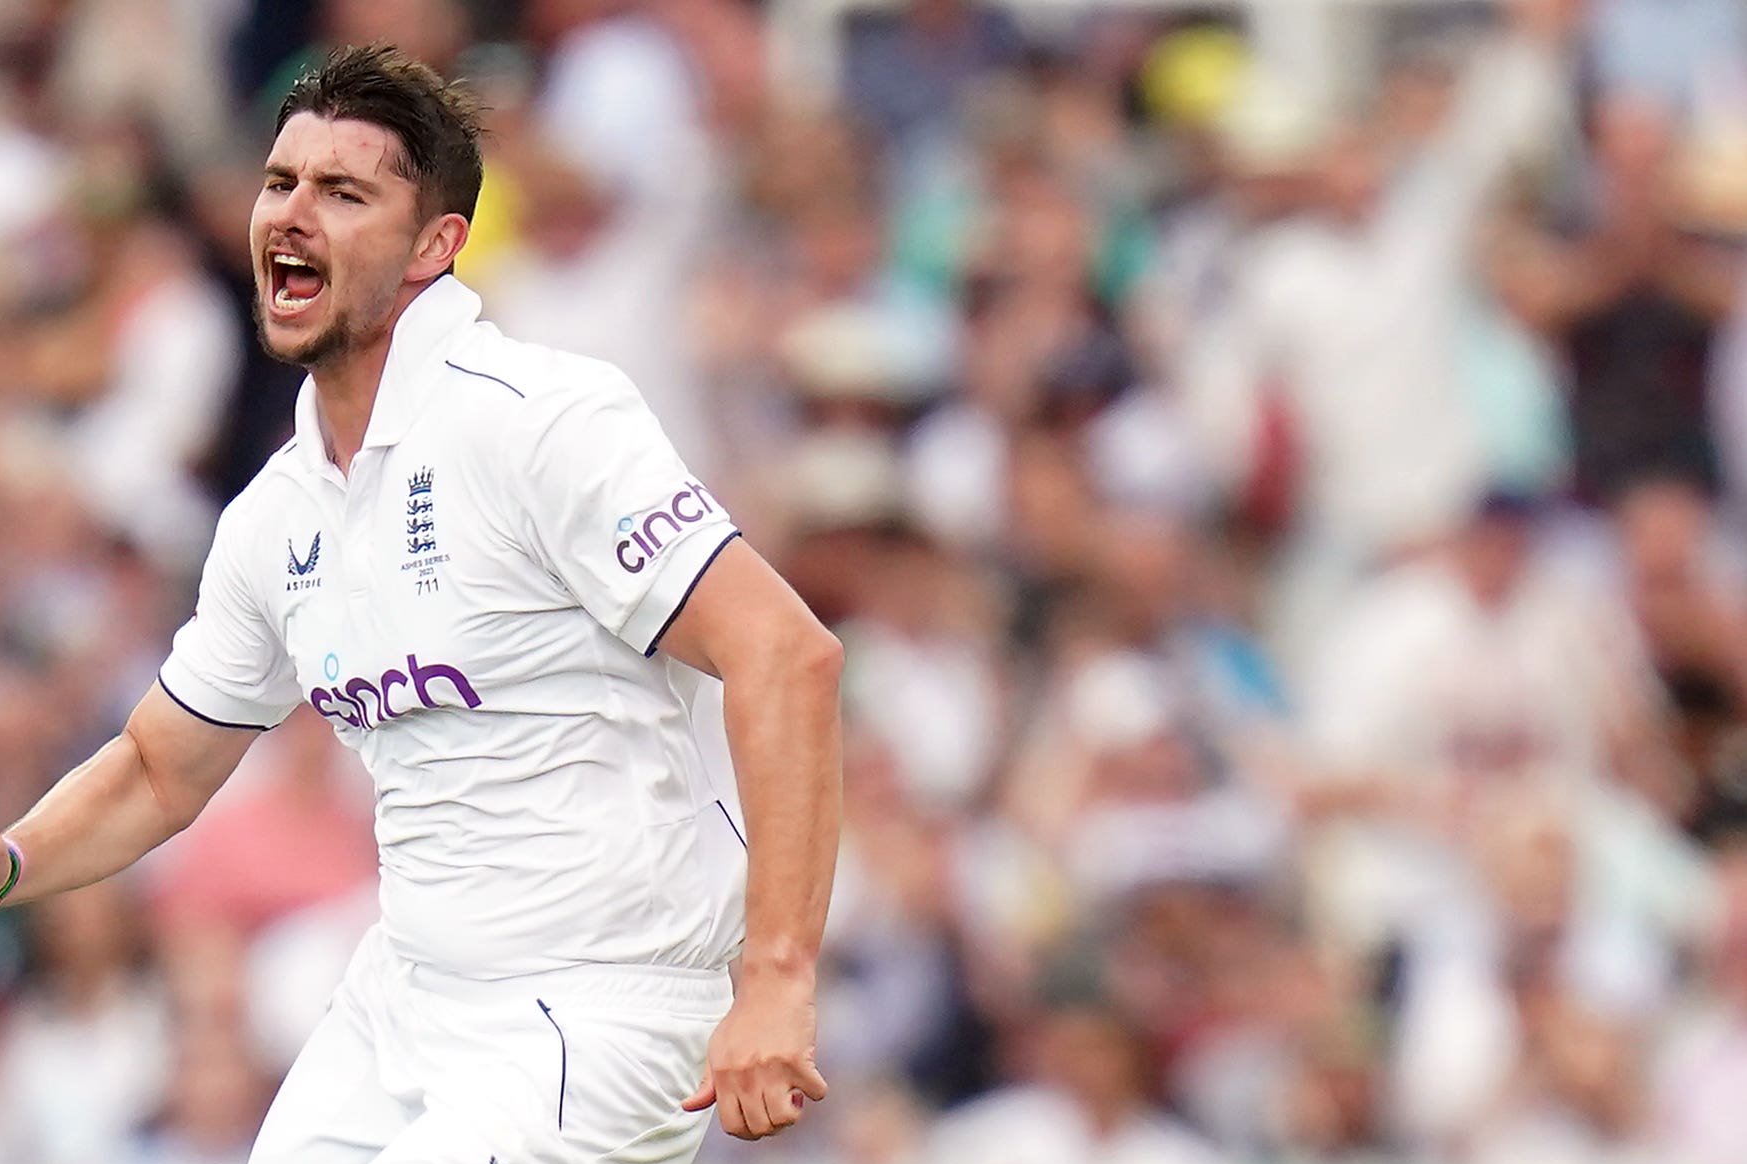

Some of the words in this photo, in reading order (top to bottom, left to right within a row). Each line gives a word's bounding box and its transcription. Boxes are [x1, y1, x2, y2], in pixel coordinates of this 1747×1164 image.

[616, 481, 713, 574] cinch
[415, 577, 439, 596] 711
[310, 653, 483, 730] cinch
